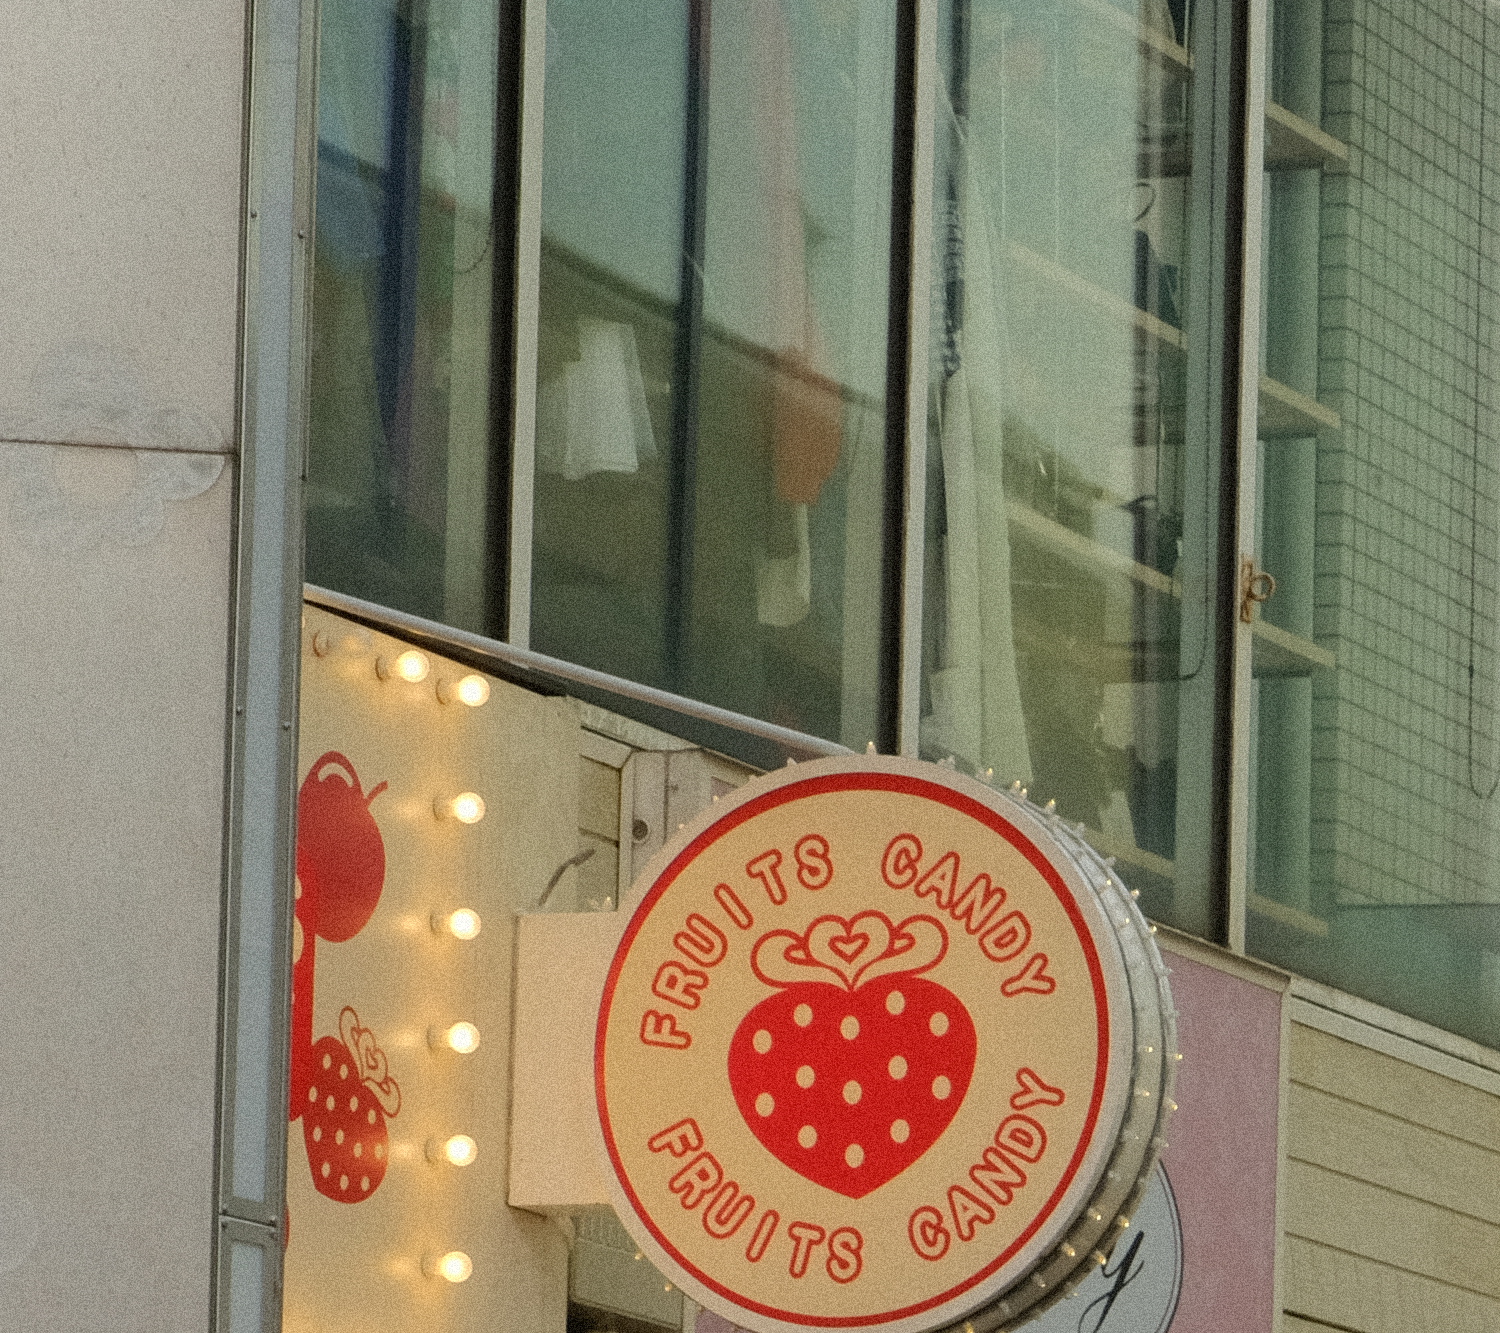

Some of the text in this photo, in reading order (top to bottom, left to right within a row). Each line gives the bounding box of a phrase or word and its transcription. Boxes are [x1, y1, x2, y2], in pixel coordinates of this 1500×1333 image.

[639, 832, 1057, 1051] FRUITS CANDY
[645, 1115, 865, 1285] FRUITS
[908, 1066, 1066, 1264] CANDY
